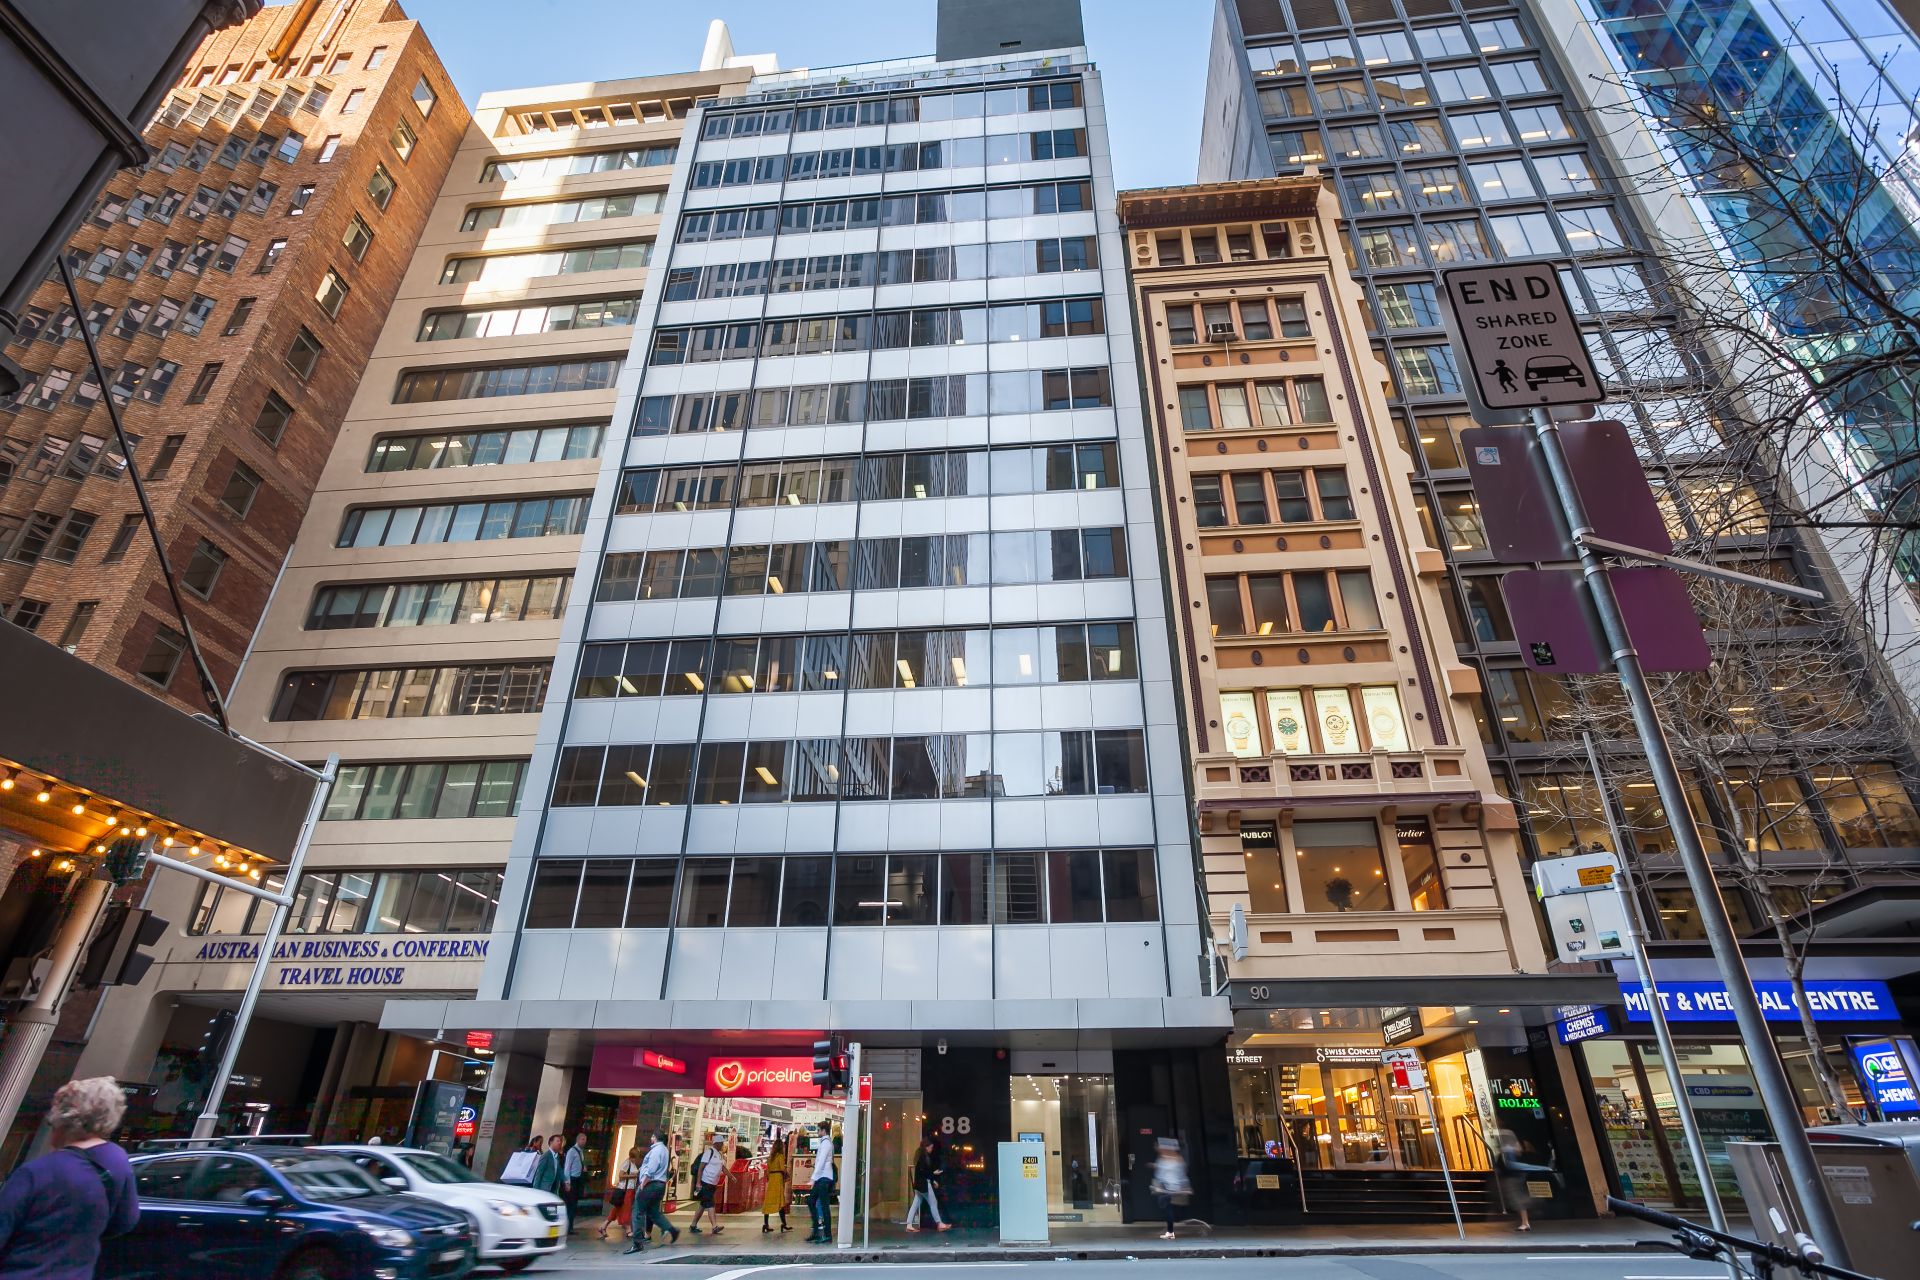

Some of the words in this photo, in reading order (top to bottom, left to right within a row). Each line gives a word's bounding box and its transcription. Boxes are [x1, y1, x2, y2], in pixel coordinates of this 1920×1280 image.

[1459, 276, 1550, 304] END
[1476, 312, 1557, 329] SHARED
[1497, 334, 1552, 350] ZONE
[196, 941, 301, 959] AUSTRAIAN
[301, 941, 378, 958] BUSINESS
[279, 967, 343, 985] TRAVEL
[348, 967, 405, 985] HOUSE
[1251, 986, 1270, 1000] 90
[1623, 992, 1669, 1011] MIT
[1676, 992, 1693, 1011] &
[1566, 1016, 1595, 1032] CHEMIST
[1568, 1029, 1587, 1040] MEDICAL
[1586, 1025, 1604, 1035] CENTRE
[747, 1068, 812, 1086] priceline
[1498, 1098, 1540, 1108] ROLEX
[942, 1116, 970, 1134] 88
